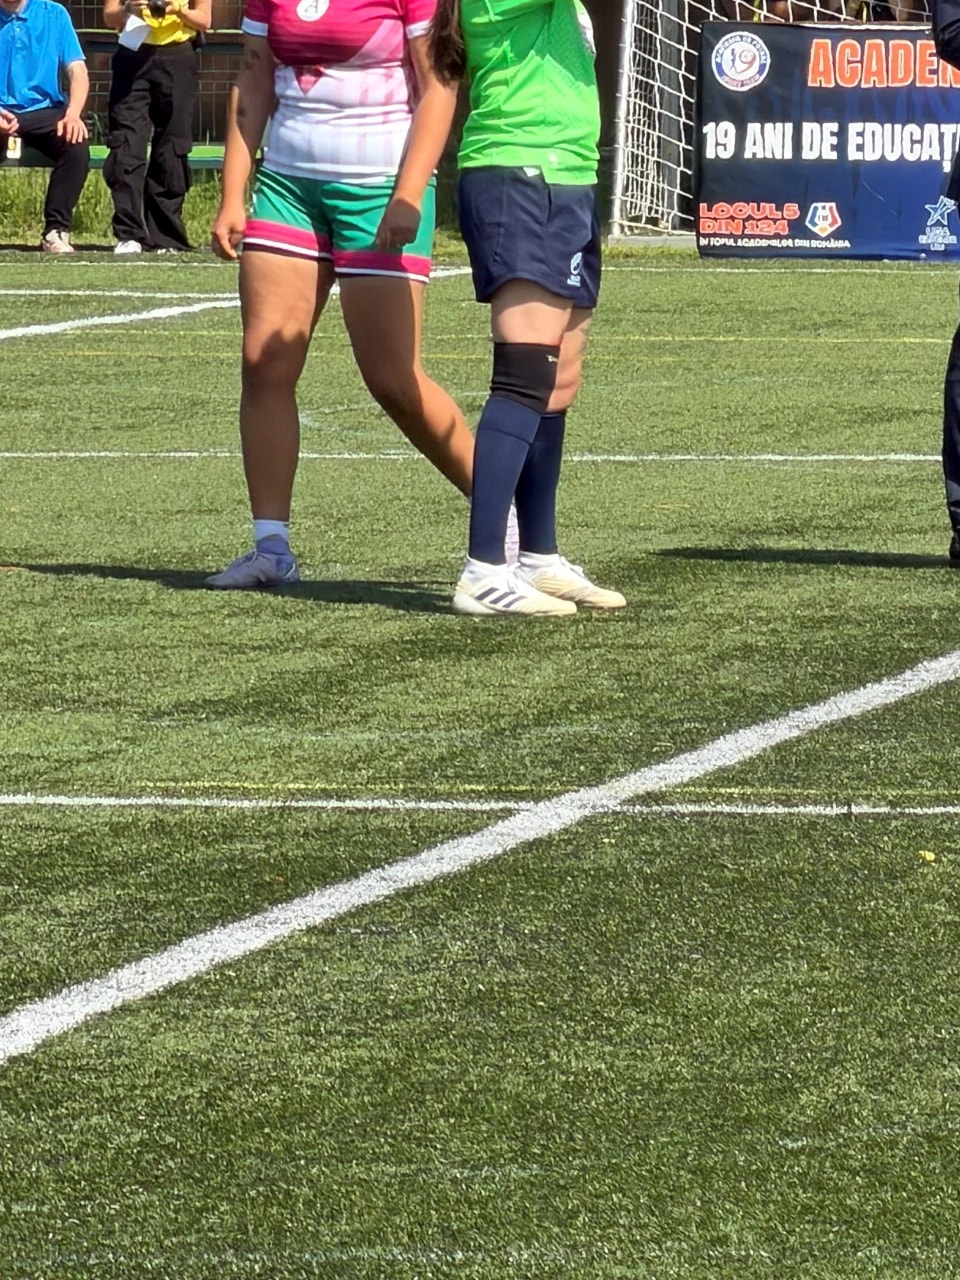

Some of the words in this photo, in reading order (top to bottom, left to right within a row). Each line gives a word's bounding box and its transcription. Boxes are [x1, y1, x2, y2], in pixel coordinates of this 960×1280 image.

[703, 121, 736, 160] 19
[744, 122, 793, 160] ANI
[802, 122, 839, 160] DE
[783, 203, 800, 219] 5
[699, 219, 743, 235] DIN
[744, 219, 789, 235] 124
[710, 237, 736, 247] TOPUL
